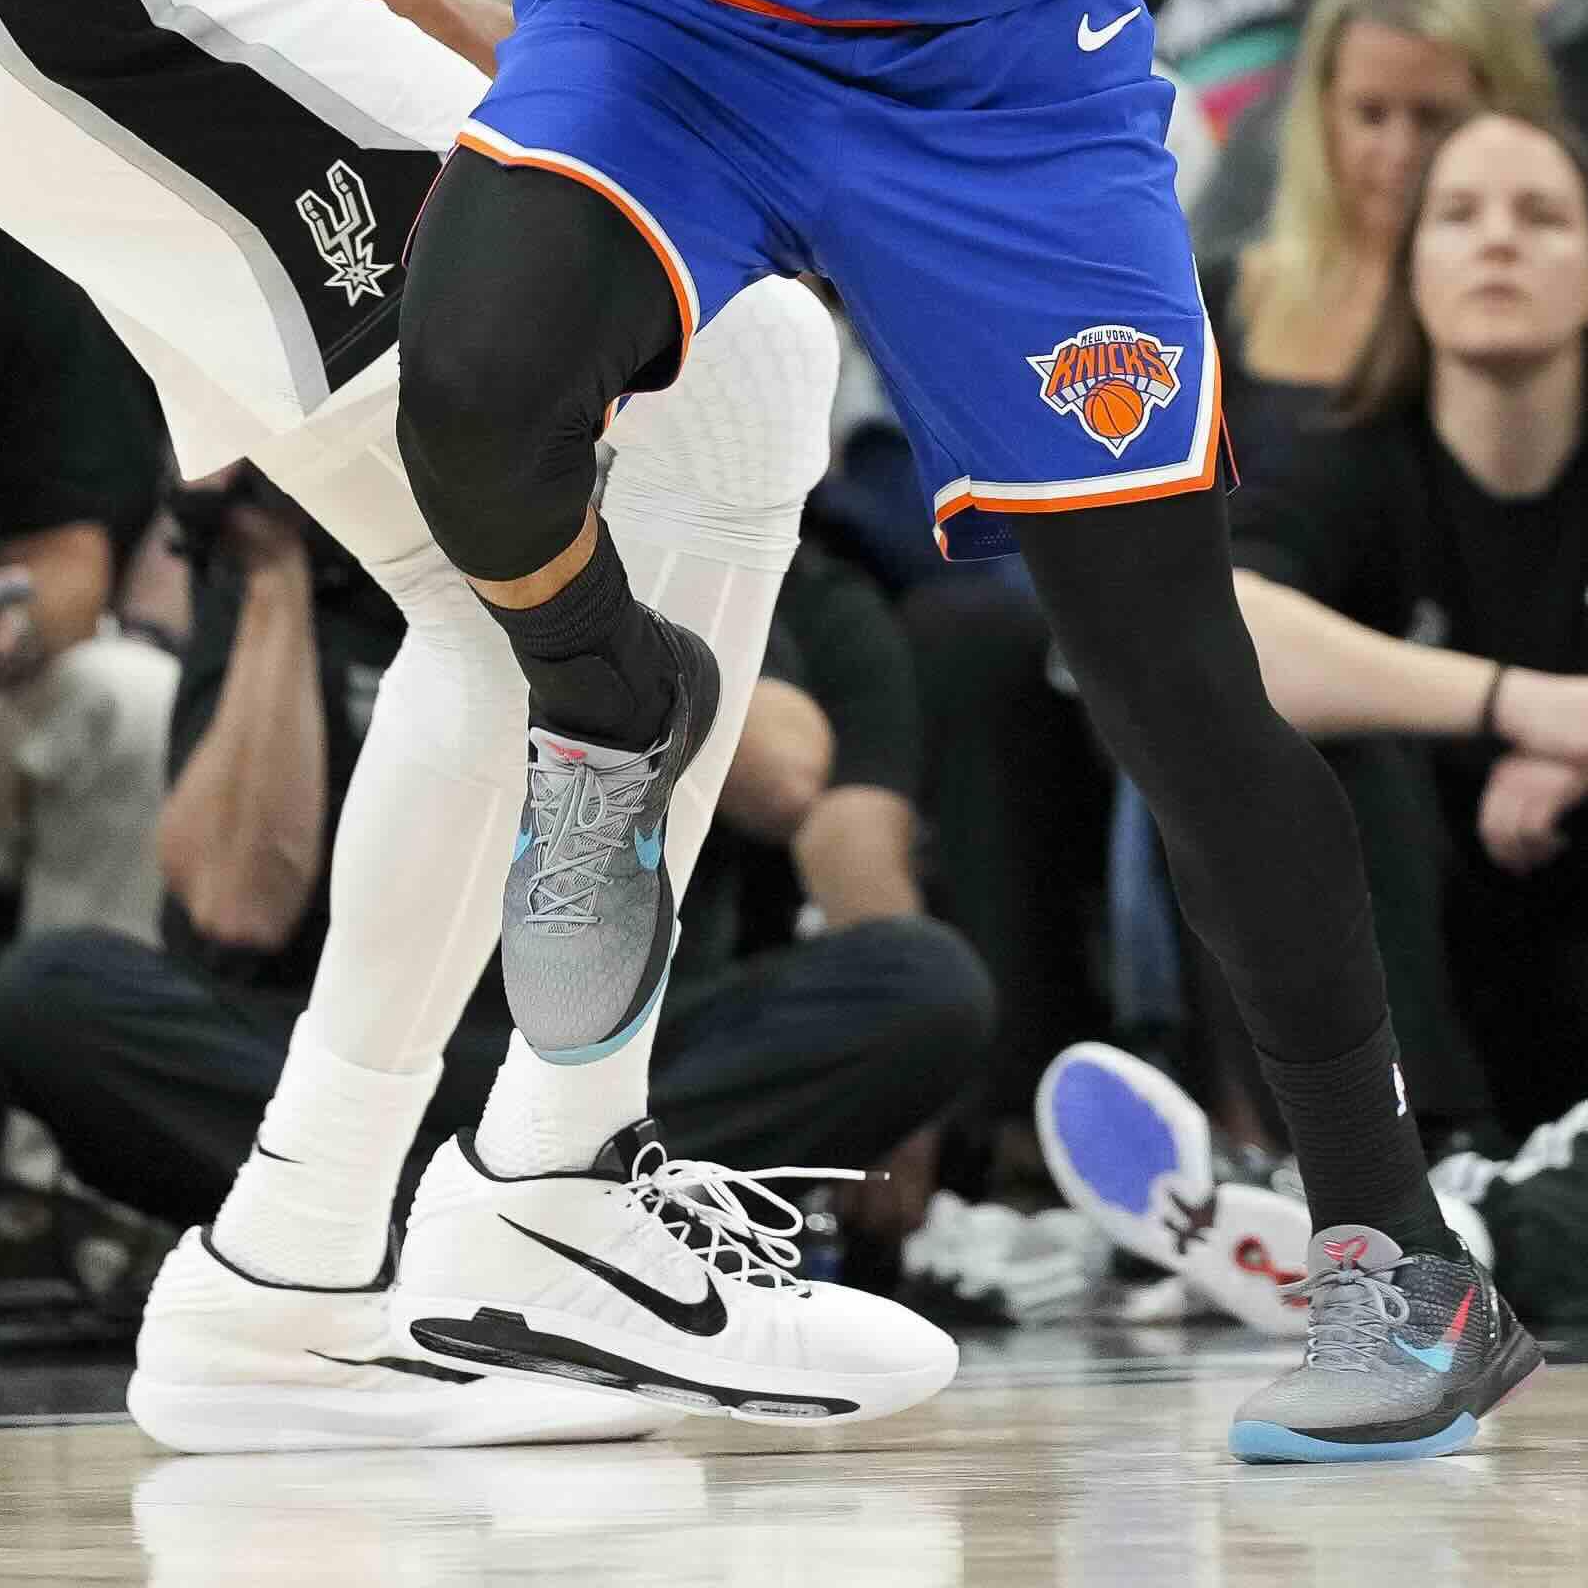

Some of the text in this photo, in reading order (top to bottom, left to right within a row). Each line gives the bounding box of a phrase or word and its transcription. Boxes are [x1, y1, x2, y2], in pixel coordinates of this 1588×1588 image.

[1080, 330, 1135, 346] NEW YORK
[1044, 337, 1176, 398] KNICKS
